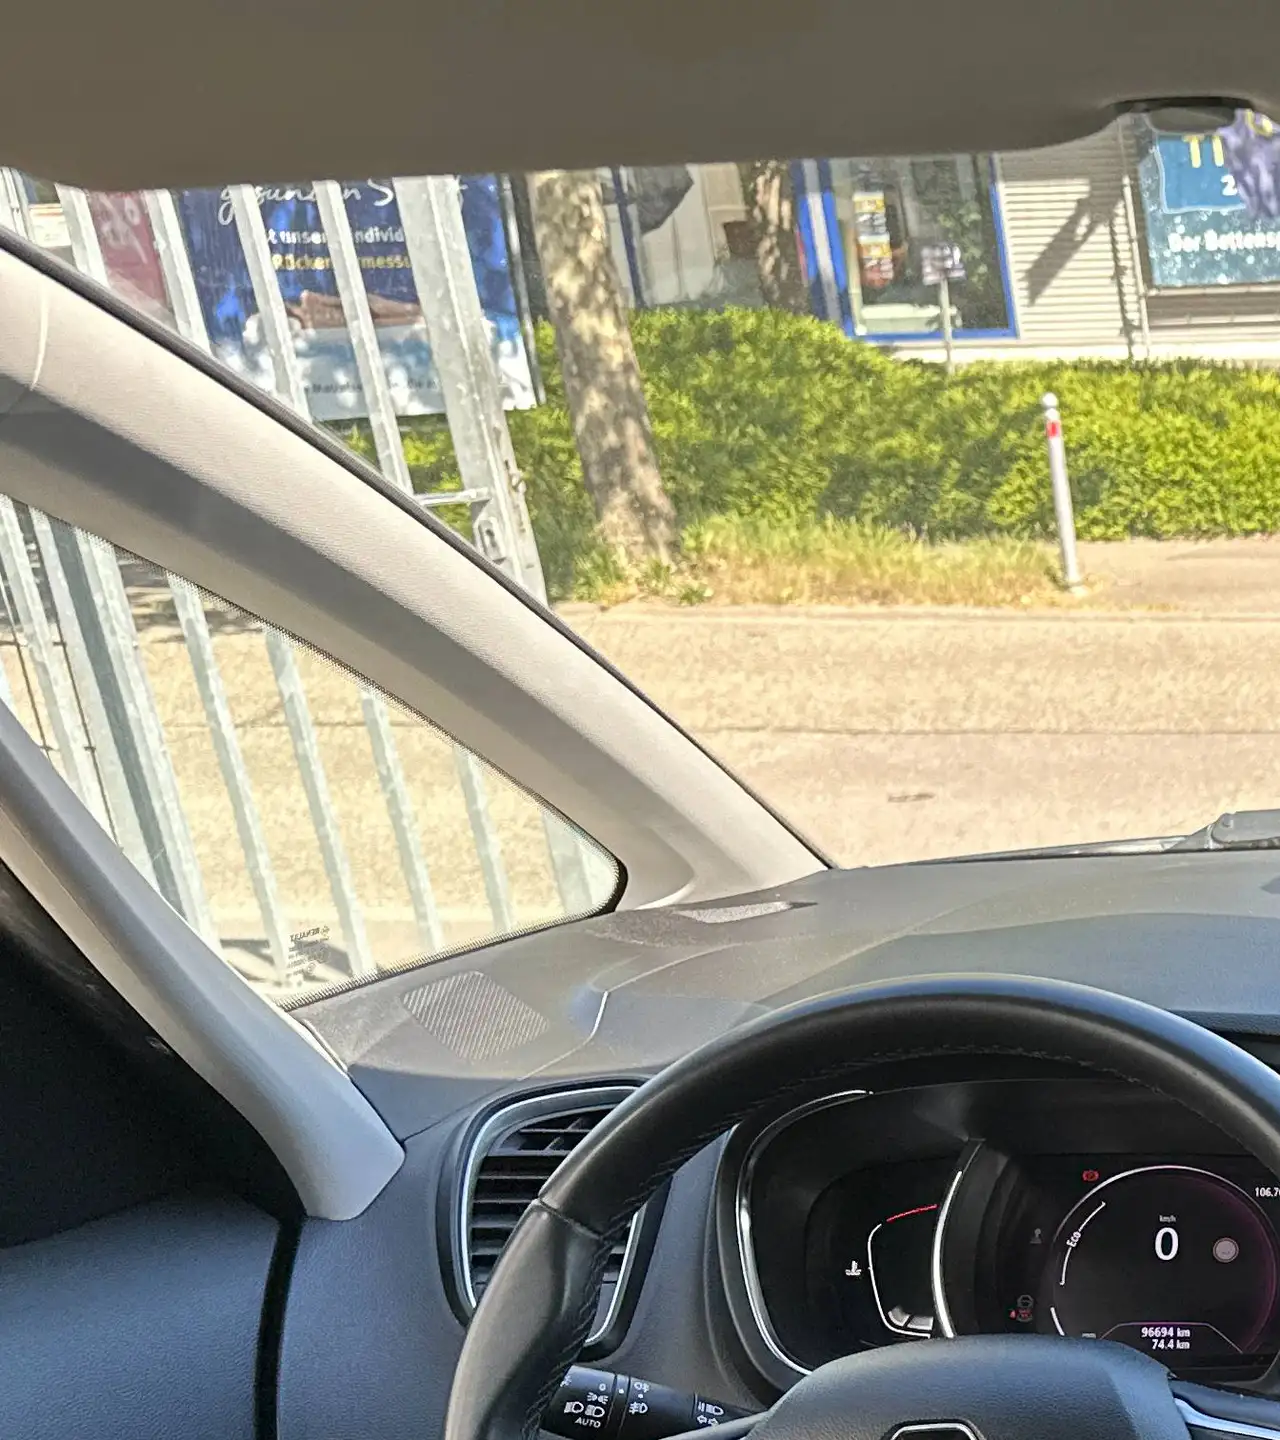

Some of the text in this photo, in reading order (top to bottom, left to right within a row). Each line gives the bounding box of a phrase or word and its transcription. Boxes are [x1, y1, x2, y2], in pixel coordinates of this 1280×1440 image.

[1159, 1214, 1177, 1223] km/h
[1154, 1227, 1179, 1261] 0
[1141, 1326, 1191, 1338] 96694 km
[1151, 1338, 1190, 1350] 74.4 km
[575, 1416, 602, 1429] AUTO
